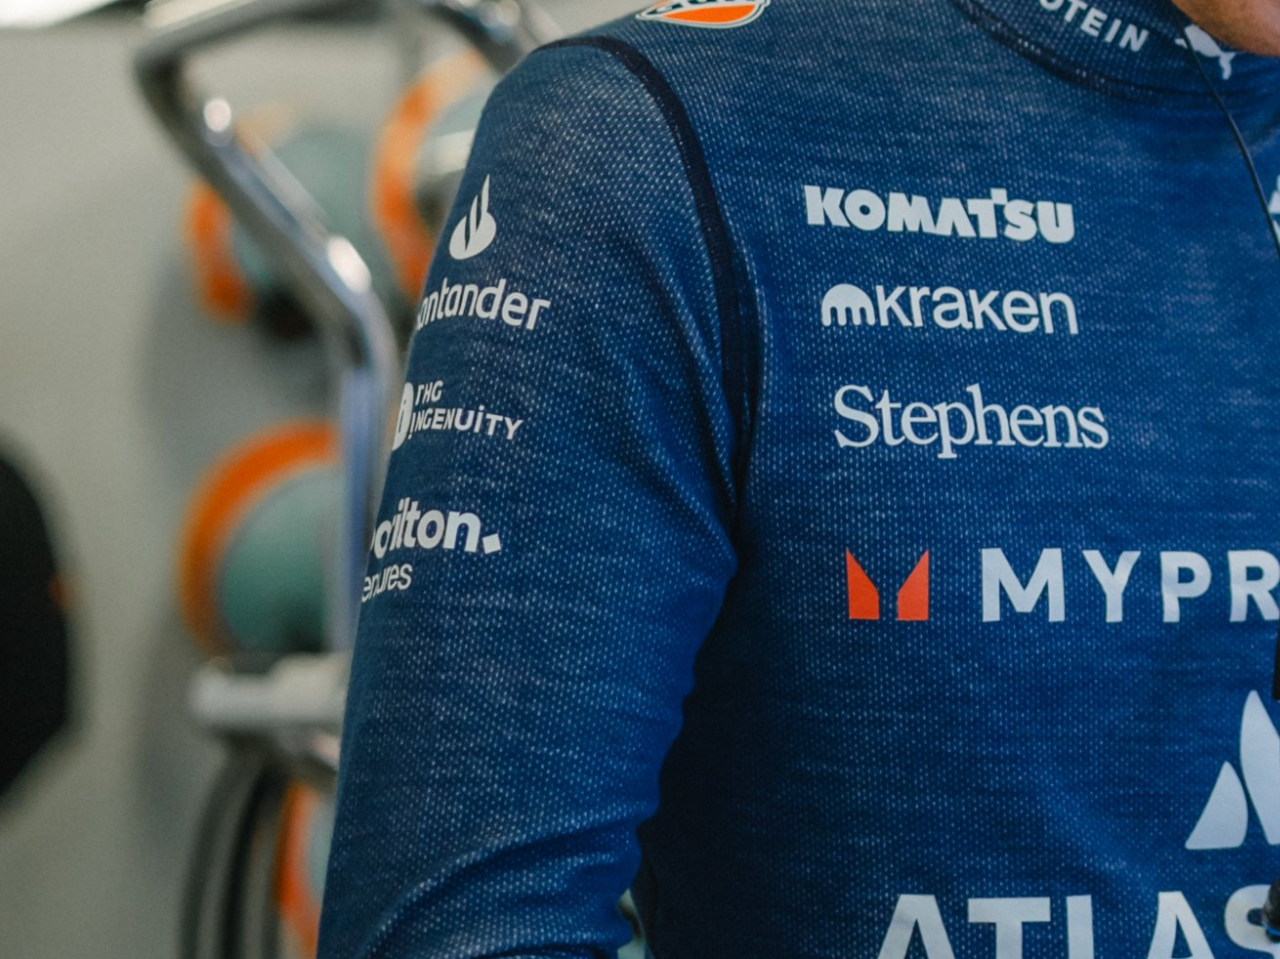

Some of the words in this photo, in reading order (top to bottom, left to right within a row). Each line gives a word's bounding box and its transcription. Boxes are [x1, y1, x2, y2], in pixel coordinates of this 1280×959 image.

[804, 185, 1075, 244] KOMATSU
[417, 277, 551, 330] antander
[833, 383, 1110, 459] Stephens
